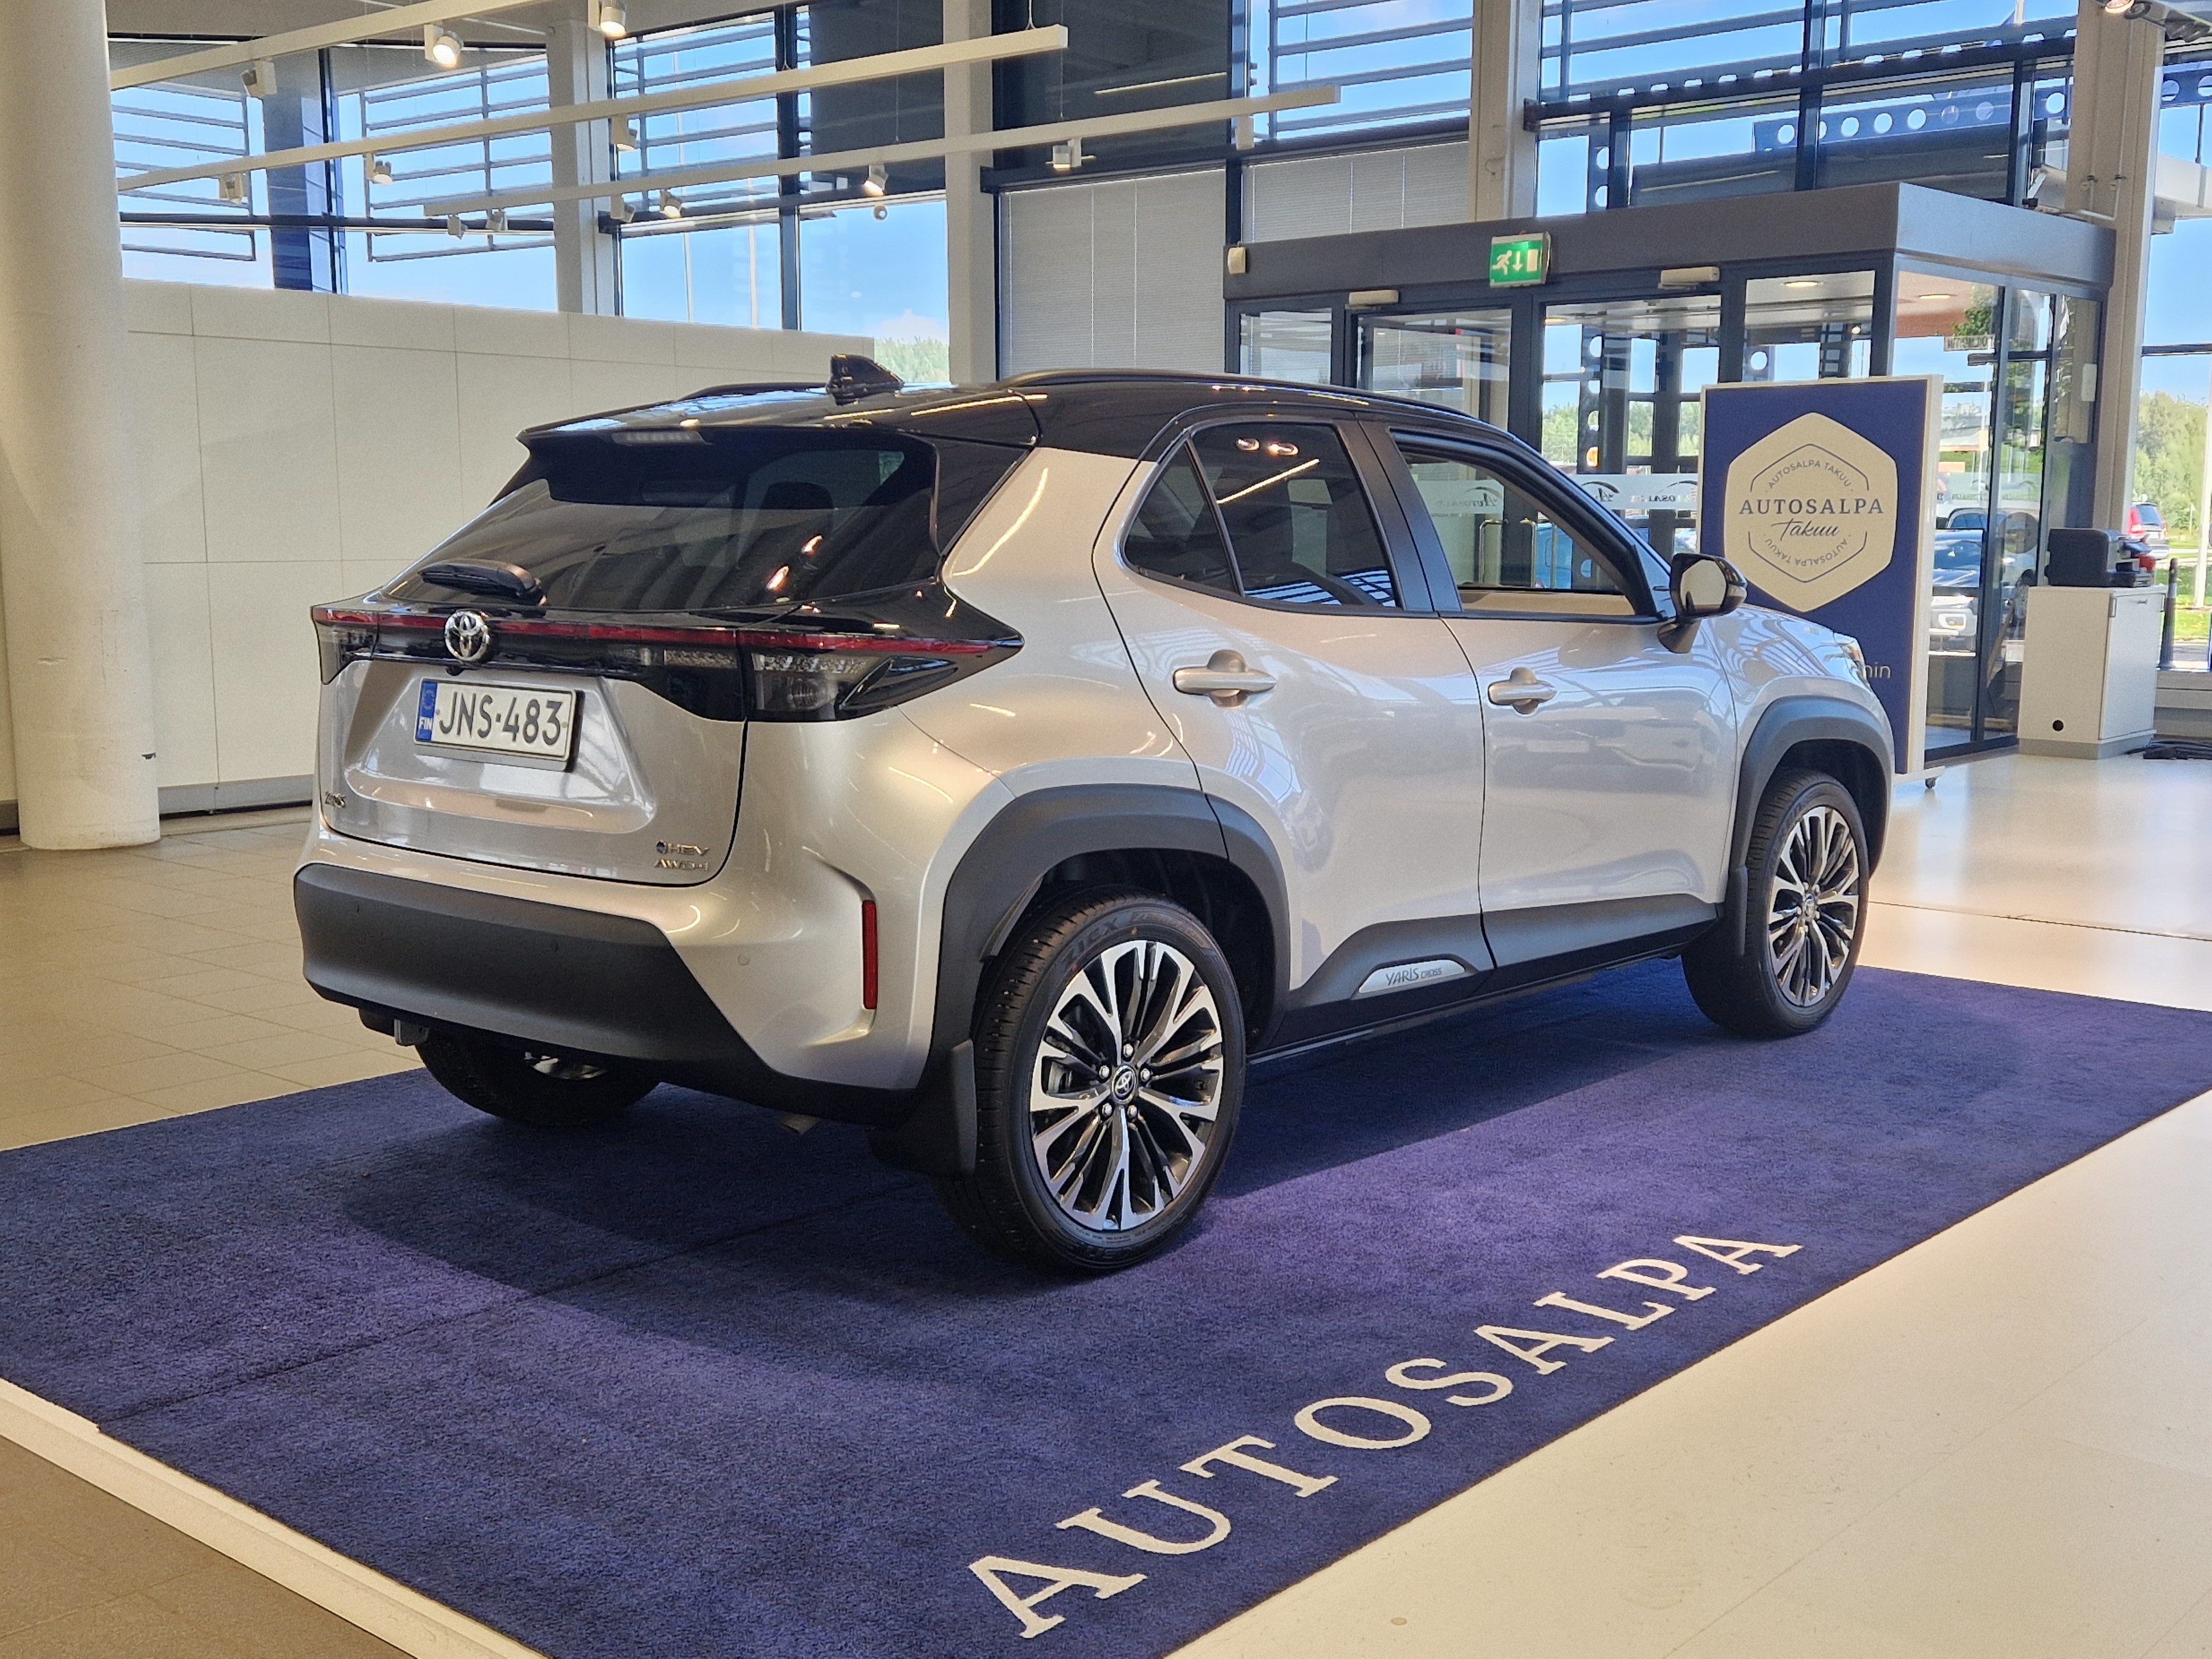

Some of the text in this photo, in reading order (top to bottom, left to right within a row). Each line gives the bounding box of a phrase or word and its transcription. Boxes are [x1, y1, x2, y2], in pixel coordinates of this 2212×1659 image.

[1768, 460, 1852, 489] AUTOSALPA TAKUU
[1739, 498, 1884, 514] AUTOSALPA
[1771, 518, 1839, 541] Takuu
[1765, 538, 1848, 566] AUTOSALPA TAKUU
[419, 716, 432, 731] FIN
[439, 691, 564, 745] JNS-483
[667, 842, 709, 856] HEV
[1385, 968, 1443, 986] YARIS CROSS
[968, 1234, 1803, 1638] AUTOSALPA
